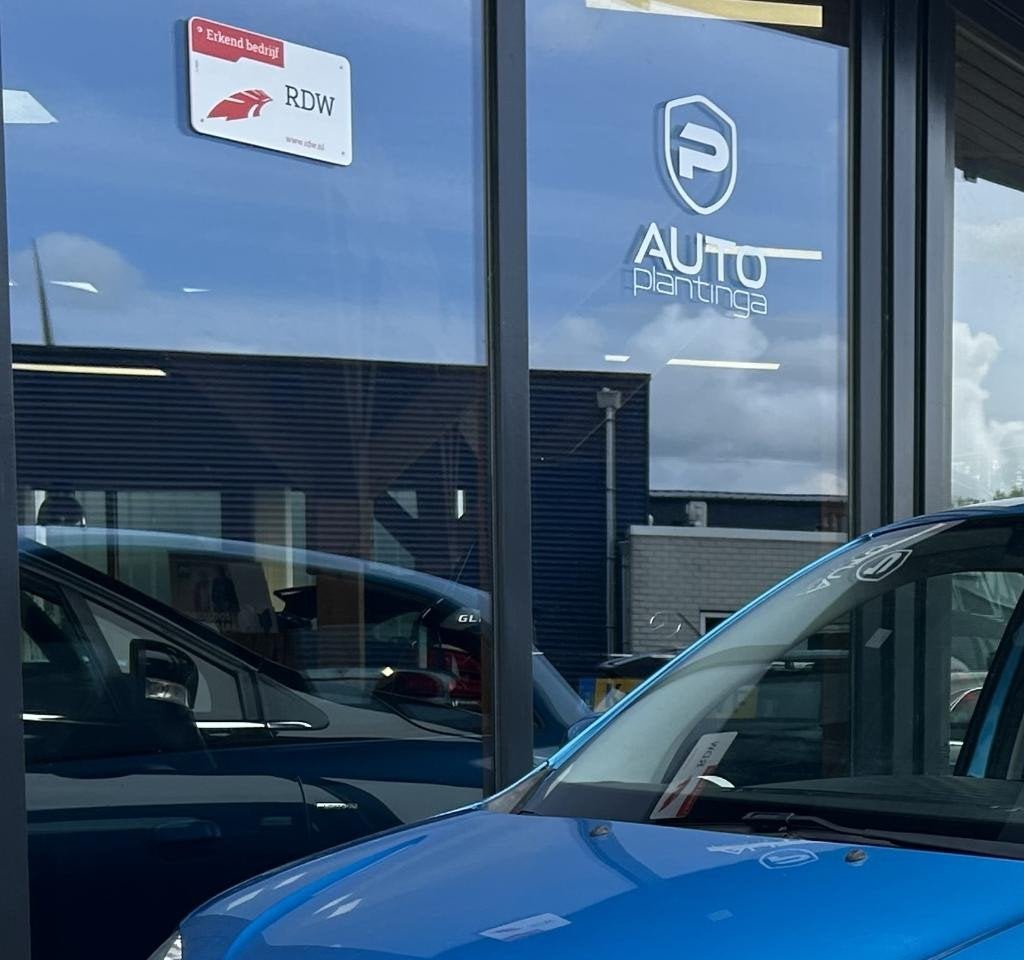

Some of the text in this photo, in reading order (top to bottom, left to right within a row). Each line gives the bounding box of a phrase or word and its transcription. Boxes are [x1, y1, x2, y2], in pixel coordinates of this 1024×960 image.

[206, 28, 280, 59] Erkend bedrijf
[285, 84, 335, 117] RDW
[285, 136, 325, 151] www.rdw.nl
[634, 222, 767, 289] AUTO
[633, 266, 768, 319] plantinga
[458, 614, 482, 623] GL
